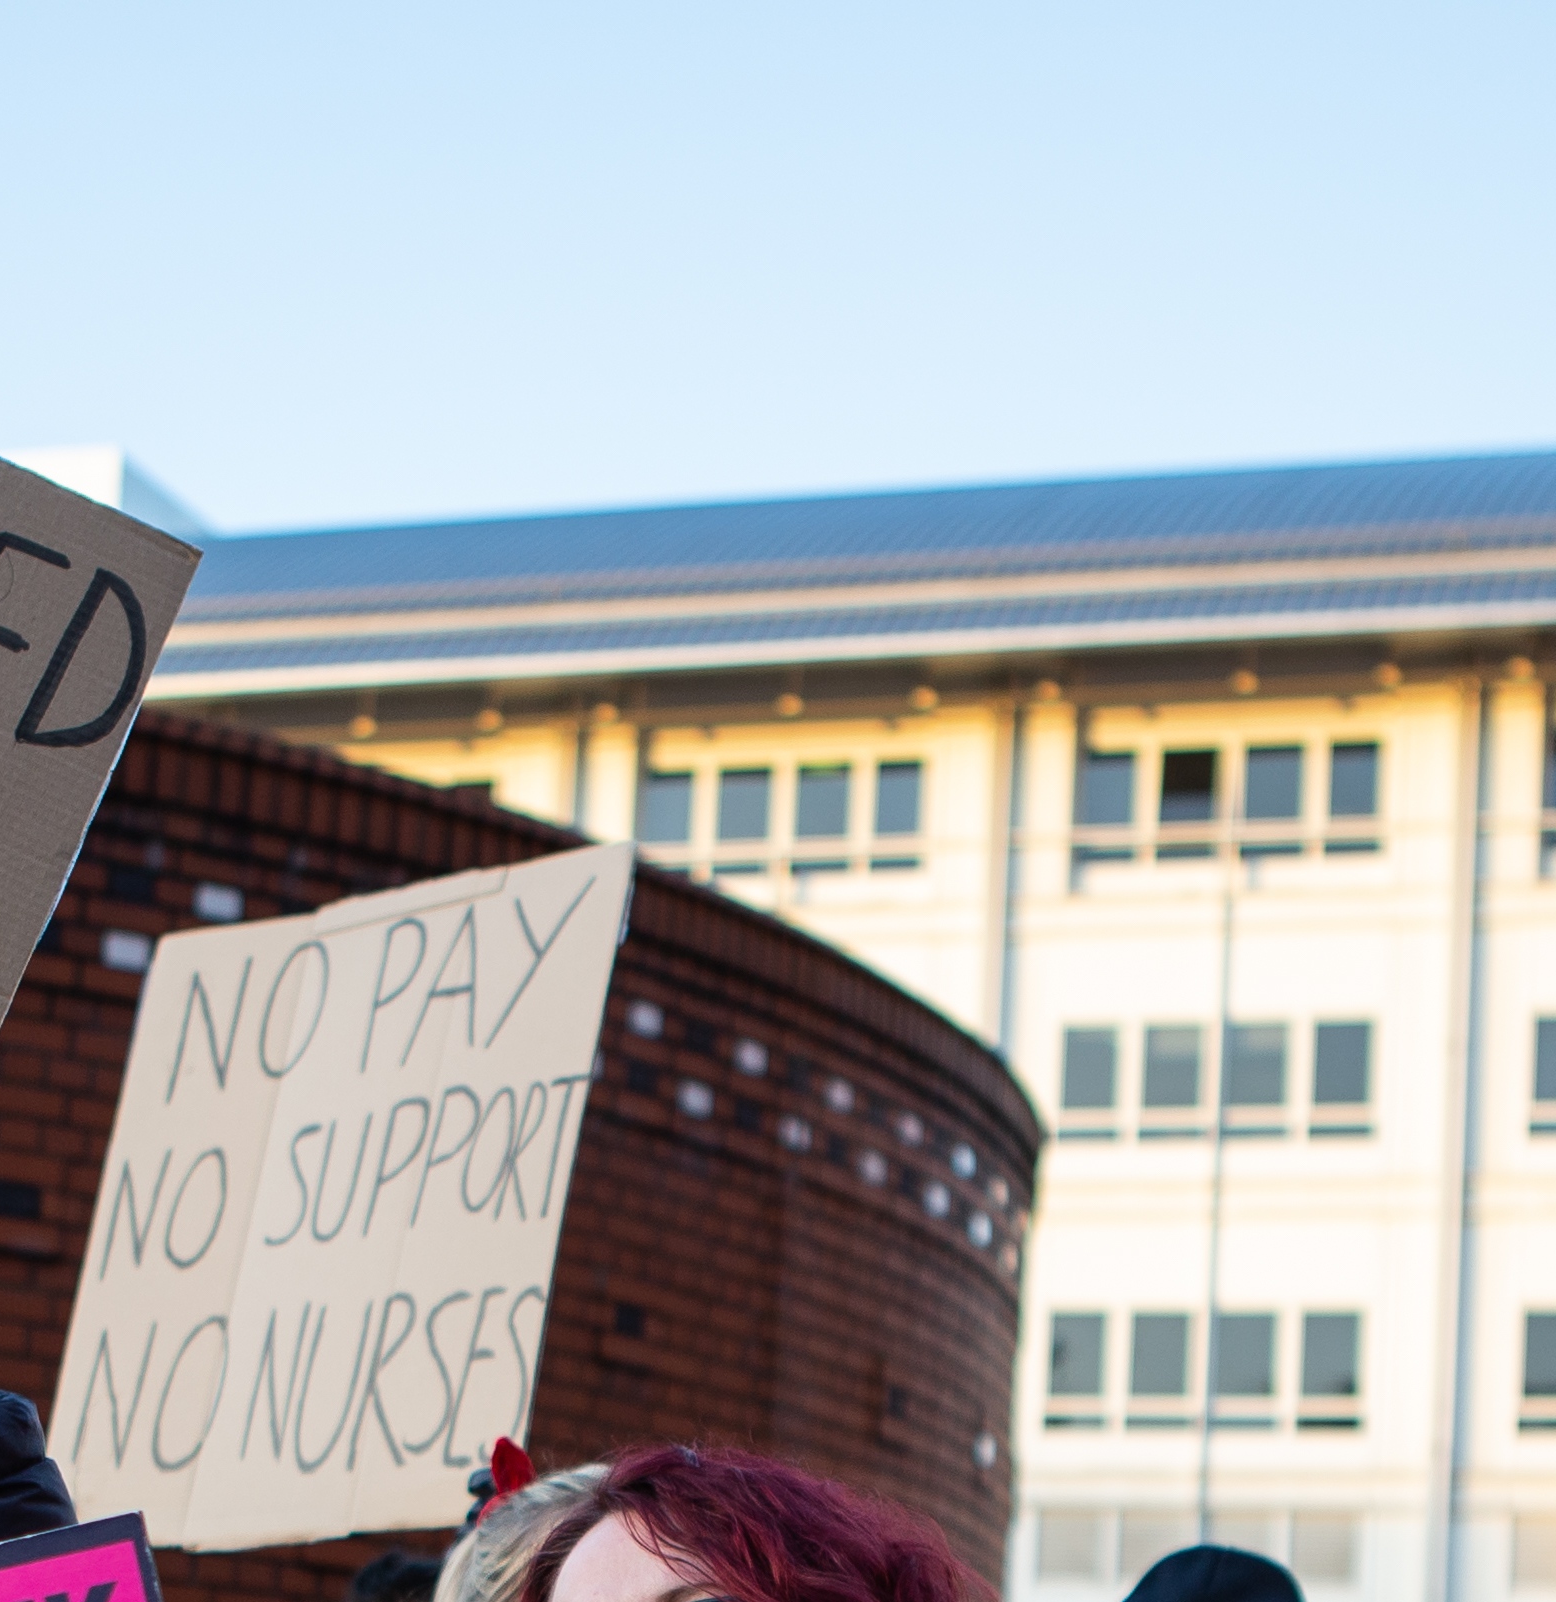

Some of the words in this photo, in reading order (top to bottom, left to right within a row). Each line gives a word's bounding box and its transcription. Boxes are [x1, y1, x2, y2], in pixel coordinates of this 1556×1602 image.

[166, 940, 330, 1105] NO
[360, 876, 597, 1075] PAY
[99, 1147, 228, 1281] NO
[264, 1073, 591, 1247] SUPPORT
[71, 1315, 229, 1473] NO
[241, 1284, 546, 1474] NURSES
